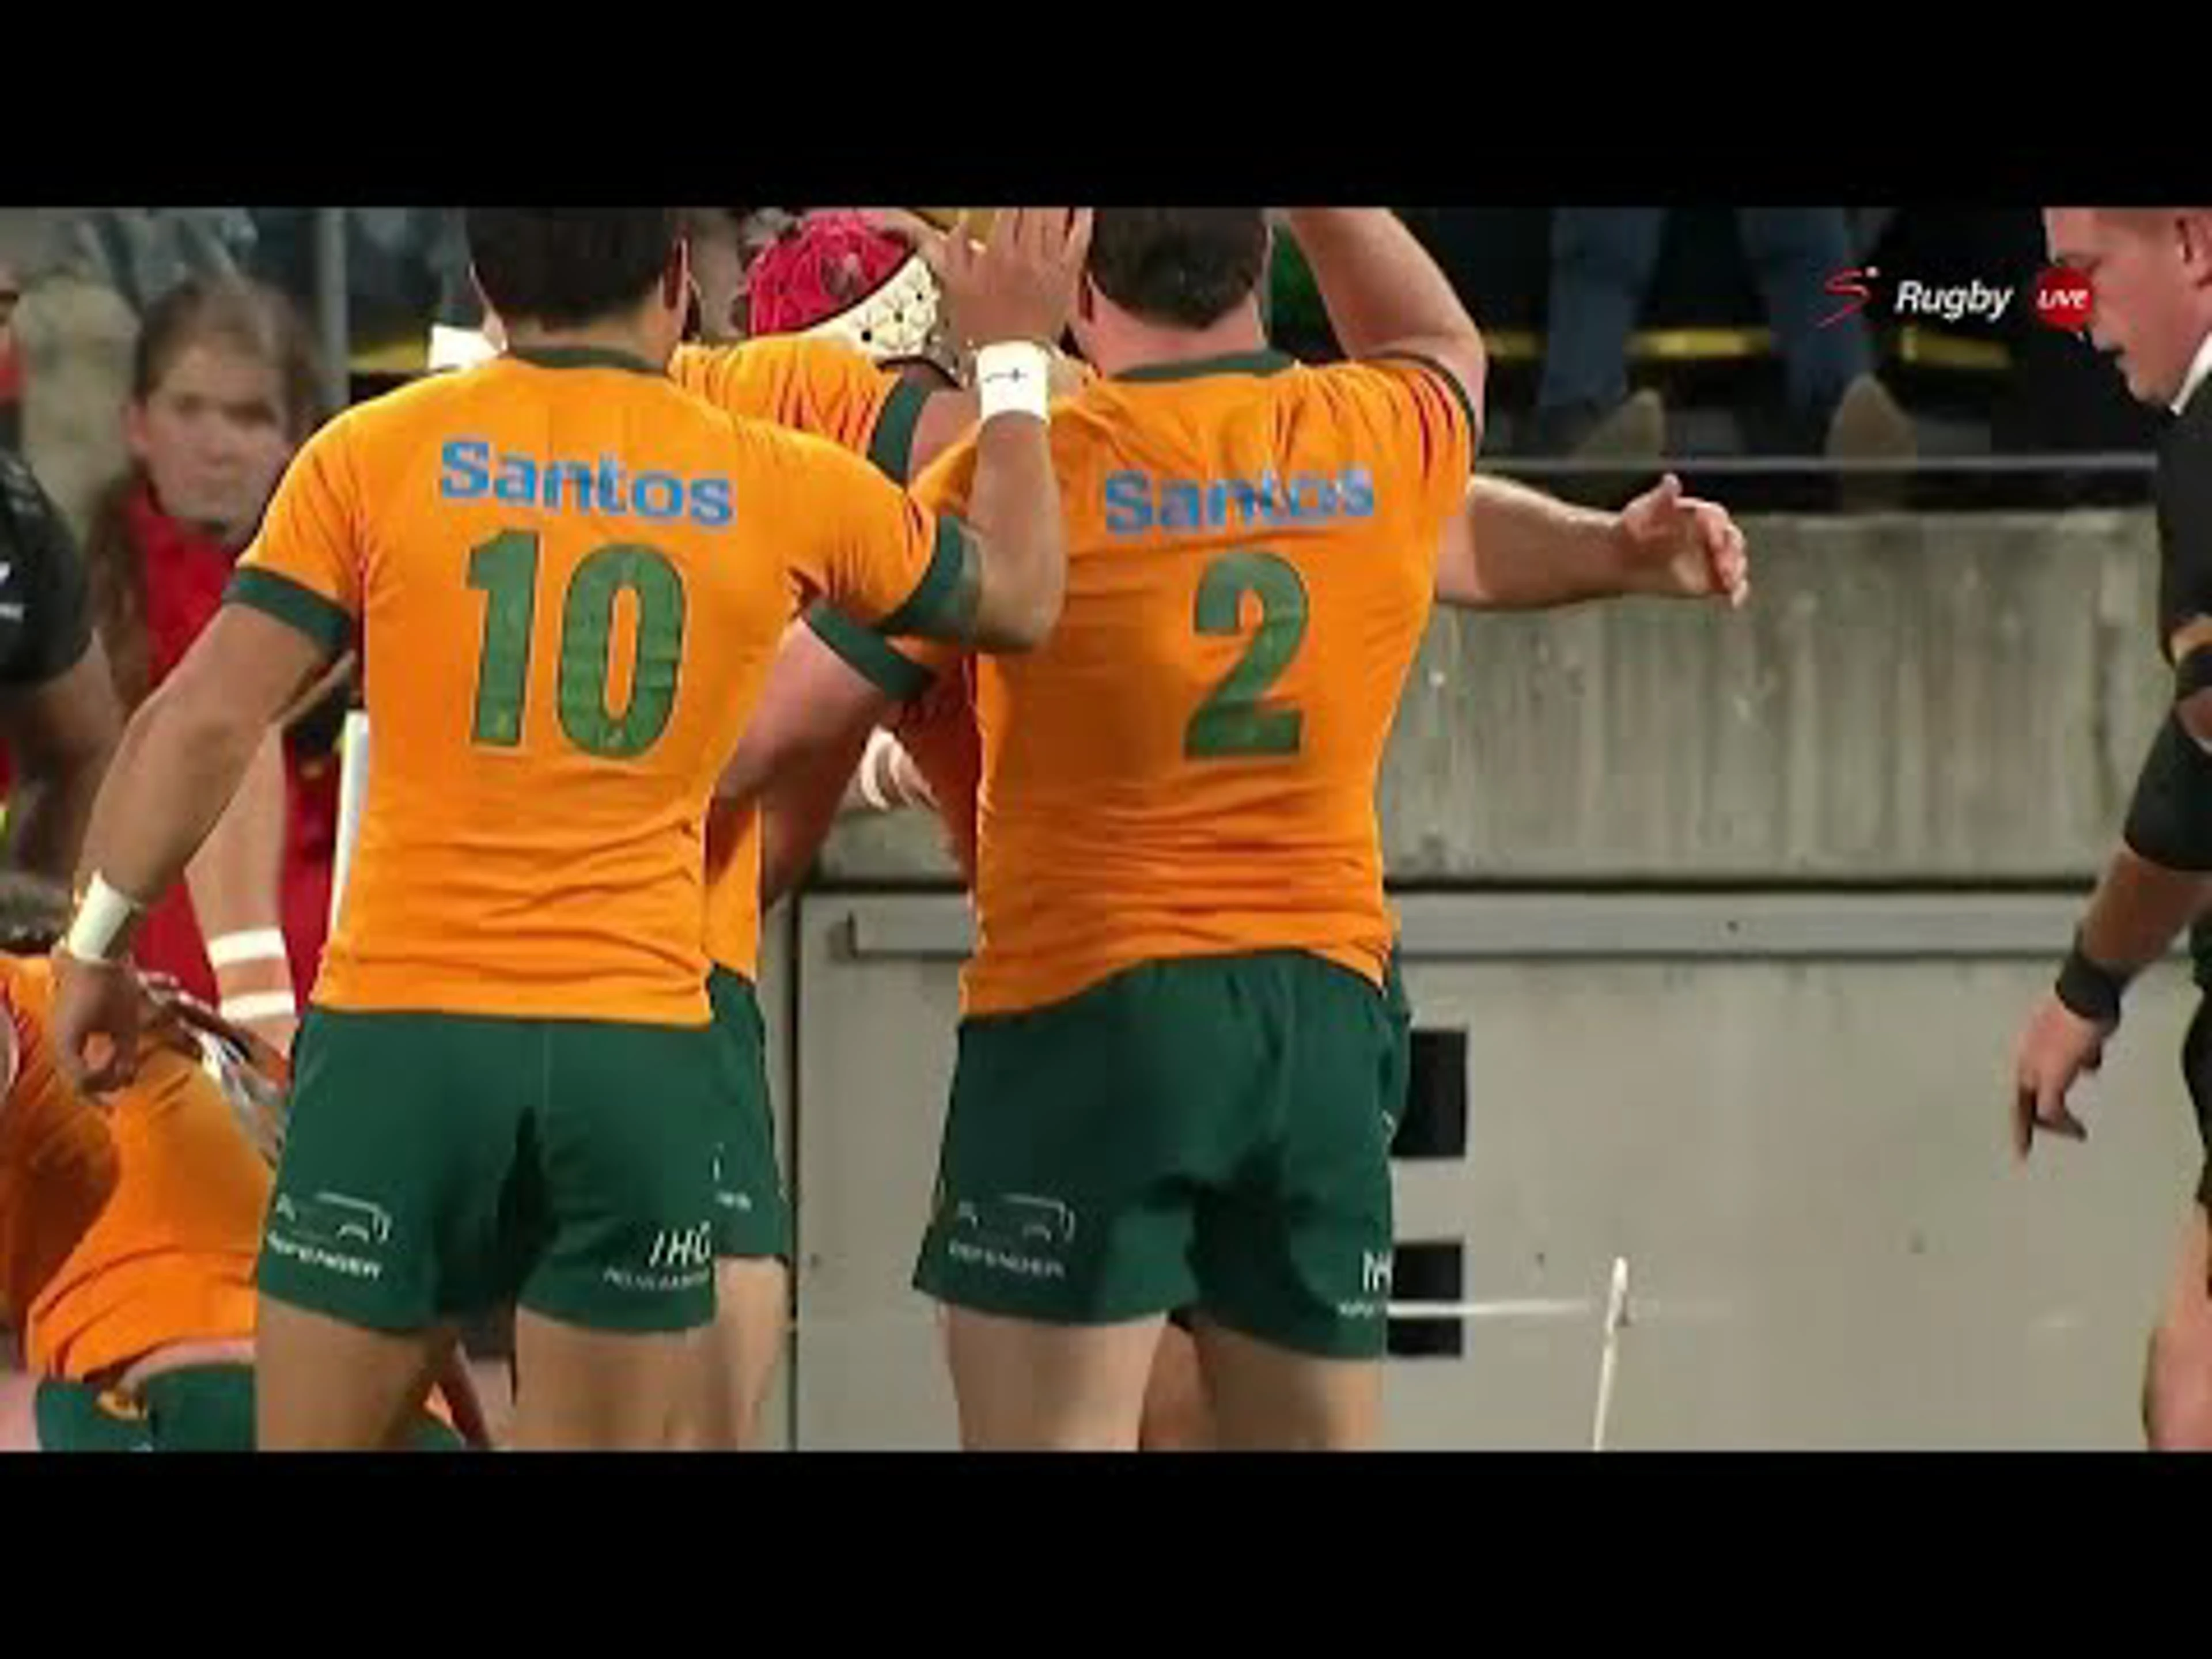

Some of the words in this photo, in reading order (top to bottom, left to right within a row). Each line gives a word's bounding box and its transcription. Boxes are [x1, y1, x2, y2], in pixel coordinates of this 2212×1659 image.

[440, 438, 734, 525] Santos
[1104, 469, 1375, 537] Santos
[466, 529, 687, 758] 10
[1183, 551, 1310, 759] 2
